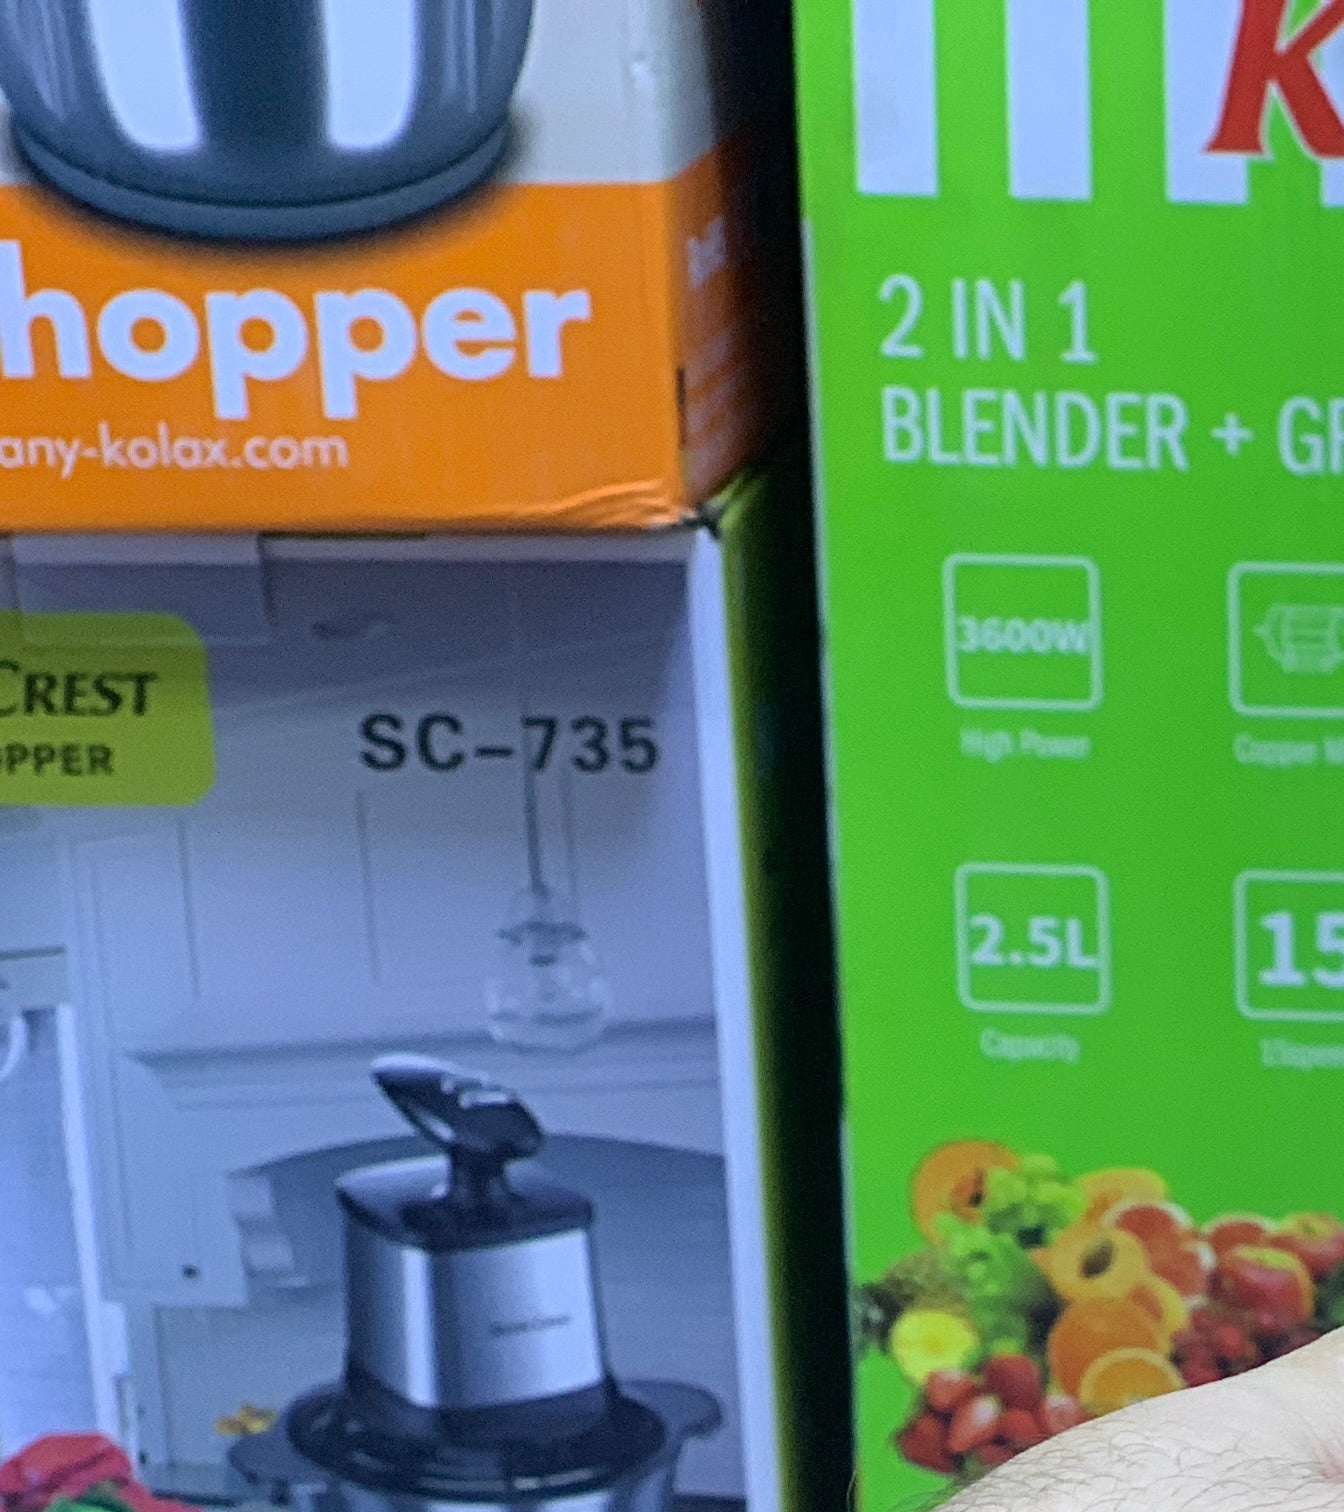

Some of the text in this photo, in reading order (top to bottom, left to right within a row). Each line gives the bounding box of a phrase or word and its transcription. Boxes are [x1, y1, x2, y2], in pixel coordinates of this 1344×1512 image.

[0, 239, 591, 421] hopper
[877, 273, 1097, 363] 2 IN 1
[881, 384, 1189, 470] BLENDER
[955, 617, 1093, 655] 3600W
[0, 743, 113, 776] PPER
[358, 713, 662, 774] SC-735
[969, 915, 1099, 969] 2.5L
